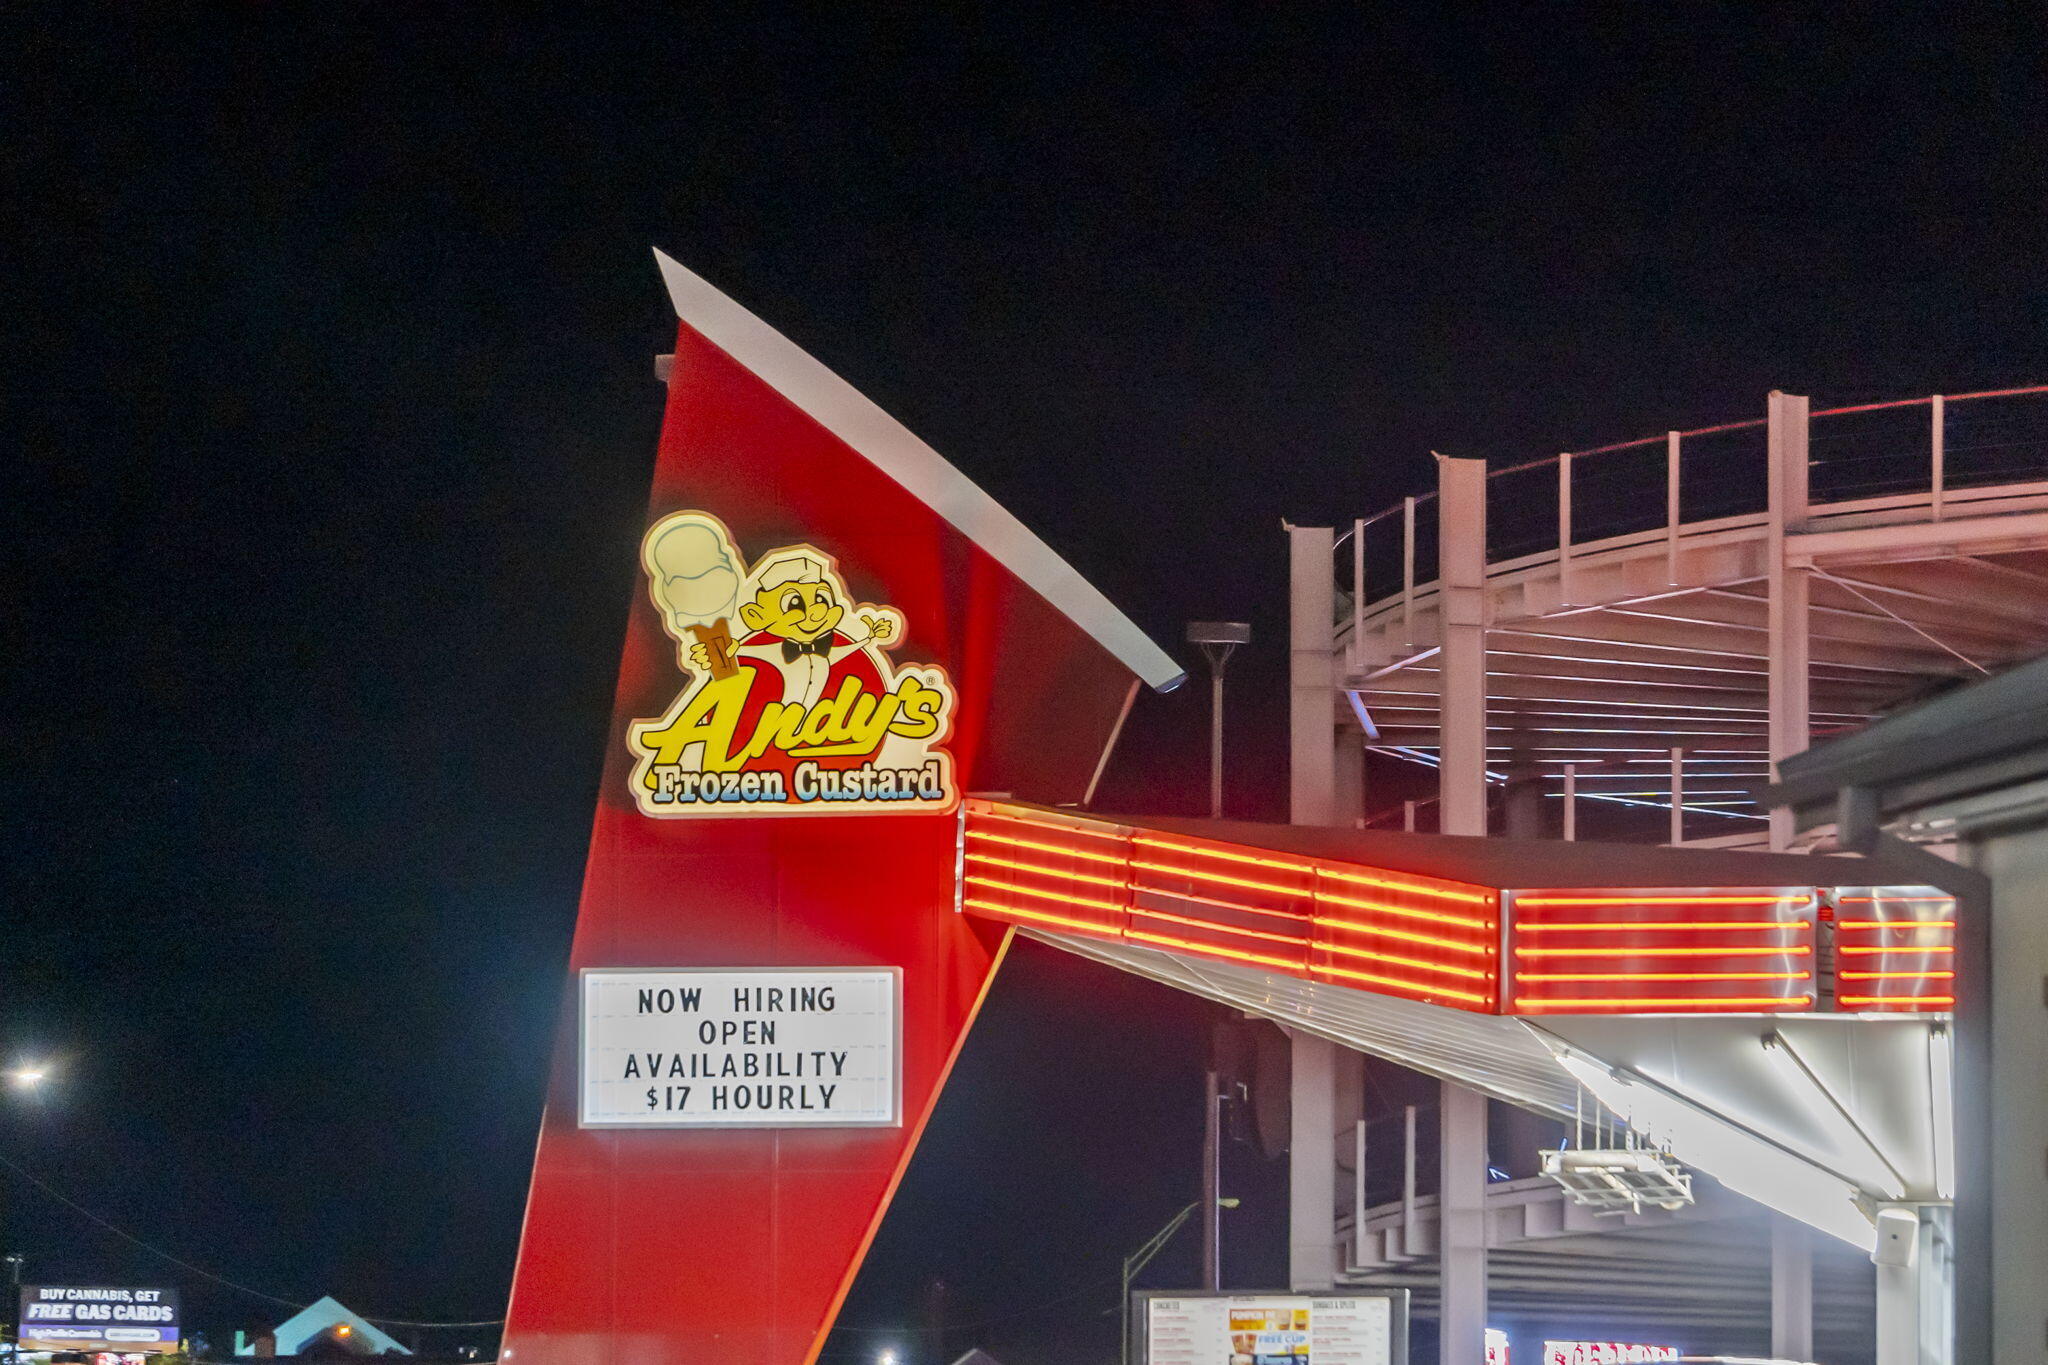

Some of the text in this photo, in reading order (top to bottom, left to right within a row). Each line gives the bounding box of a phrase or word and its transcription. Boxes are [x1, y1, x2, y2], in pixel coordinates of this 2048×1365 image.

[640, 665, 944, 791] Andy's
[652, 760, 944, 803] Frozen Custard
[638, 986, 836, 1014] NOW HIRING
[698, 1020, 776, 1045] OPEN
[624, 1051, 848, 1079] AVAILABILITY
[646, 1084, 837, 1112] $17 HOURLY
[40, 1288, 161, 1303] BUY CANNABIS, GET
[28, 1303, 173, 1321] FREE GAS CARDS
[1258, 1335, 1282, 1344] FREE
[1284, 1335, 1305, 1344] CUP
